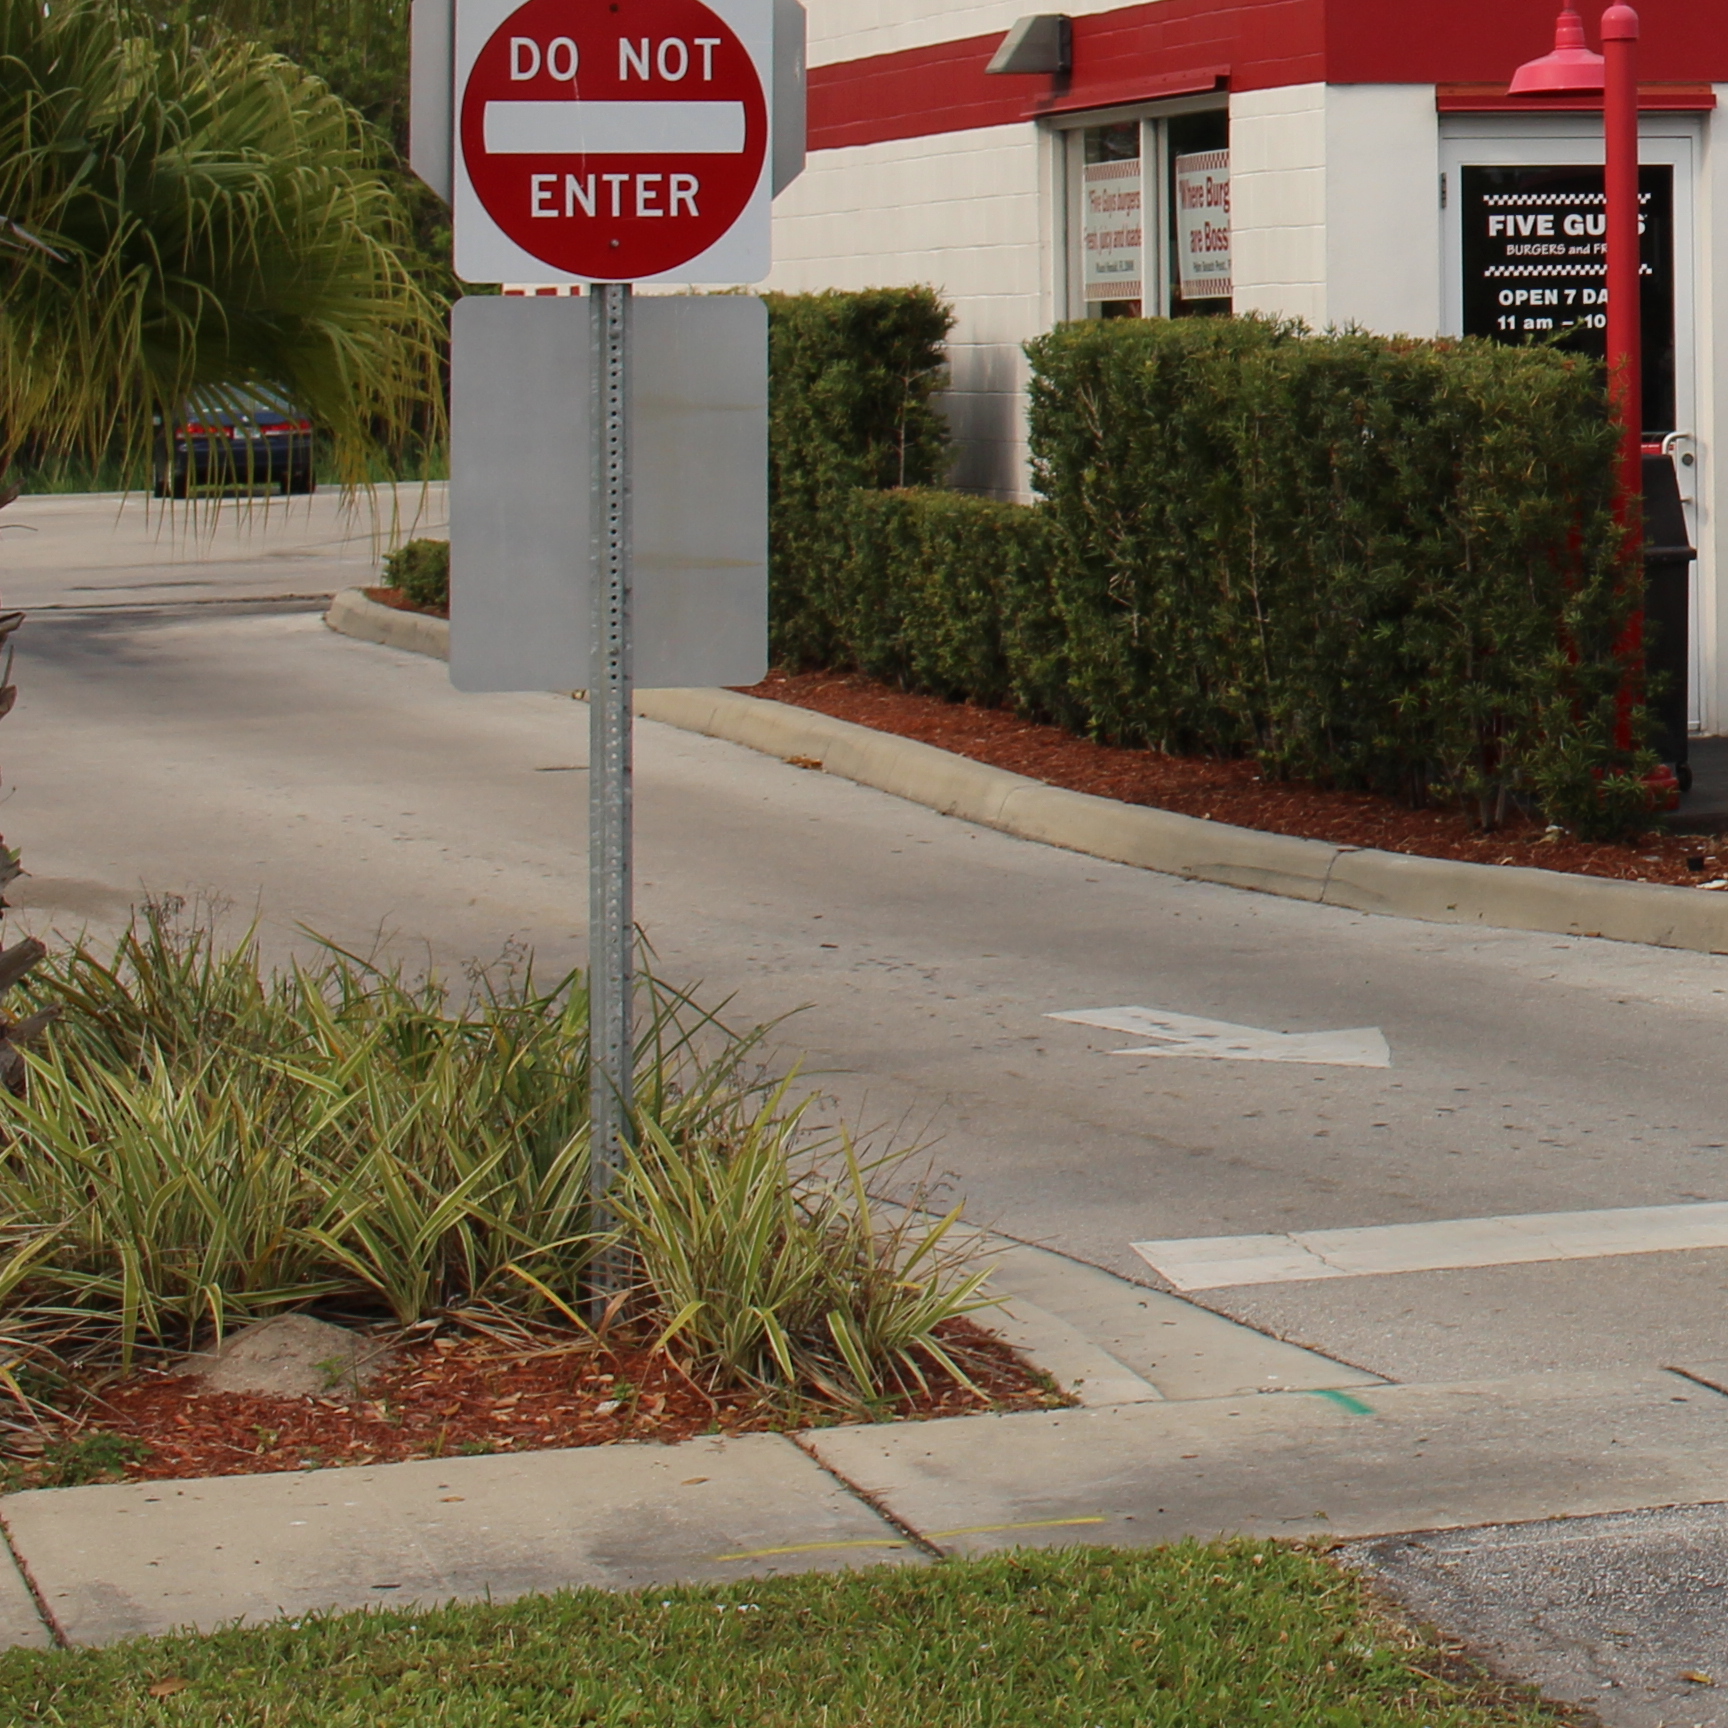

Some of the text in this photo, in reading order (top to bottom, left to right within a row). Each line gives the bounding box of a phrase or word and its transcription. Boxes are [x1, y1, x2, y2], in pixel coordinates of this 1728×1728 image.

[509, 36, 722, 82] DO NOT
[530, 173, 700, 218] ENTER
[1206, 176, 1230, 213] Burg
[1488, 214, 1555, 237] FIVE
[1506, 243, 1566, 256] BURGERS
[1568, 243, 1591, 255] and
[1498, 289, 1608, 306] OPEN 7 DA
[1497, 315, 1516, 331] 11
[1523, 317, 1553, 330] am
